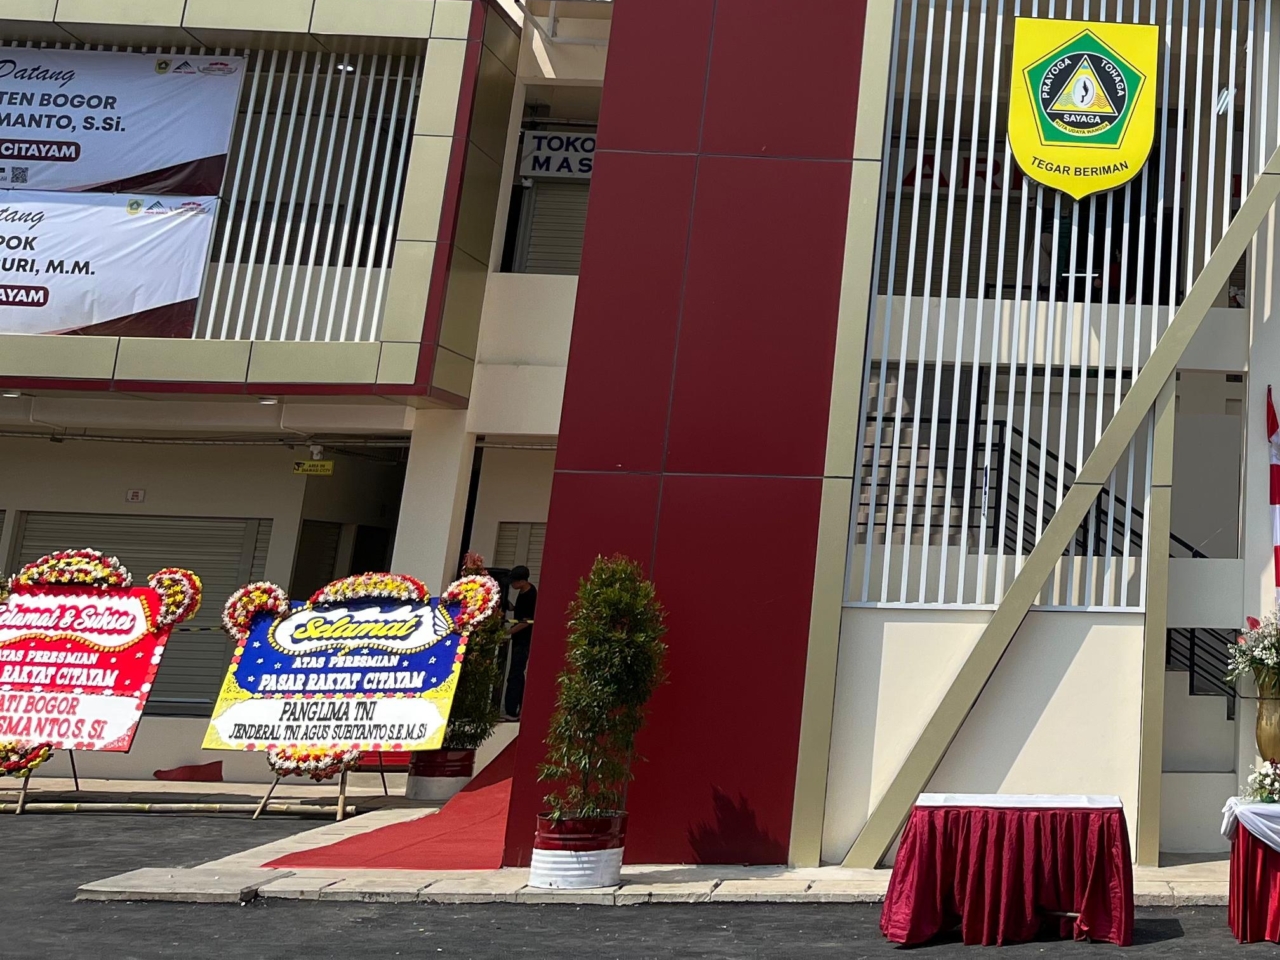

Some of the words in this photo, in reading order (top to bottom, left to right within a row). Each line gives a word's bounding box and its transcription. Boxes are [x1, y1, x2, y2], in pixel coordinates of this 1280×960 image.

[0, 59, 75, 88] Datang
[1042, 57, 1072, 99] PRAYOGA
[1100, 59, 1125, 97] TOHAGA
[39, 93, 117, 109] BOGOR
[82, 116, 126, 132] S.Si.
[1063, 114, 1101, 123] SAYAGA
[0, 142, 76, 158] CITAYAM
[532, 135, 596, 153] TOKO
[531, 155, 593, 173] MAS
[1031, 156, 1071, 176] TEGAR
[1074, 160, 1129, 177] BERIMAN
[45, 259, 95, 275] M.M.
[59, 608, 76, 628] &
[74, 606, 136, 632] Sukses
[292, 615, 420, 639] Selamat
[26, 651, 99, 664] PERESMIAN
[292, 656, 325, 669] ATAS
[328, 655, 400, 669] PERESMIAN
[2, 665, 57, 684] RAKYAT
[56, 668, 119, 687] CITAYAM
[258, 673, 305, 691] PASAR
[306, 672, 361, 690] RAKYAT
[363, 671, 425, 689] CITAYAM
[23, 695, 79, 716] BOGOR
[279, 701, 350, 722] PANGLIMA
[354, 701, 377, 722] TNI
[228, 723, 281, 740] JENDERAL
[283, 725, 301, 740] TNI
[301, 725, 331, 740] AGUS
